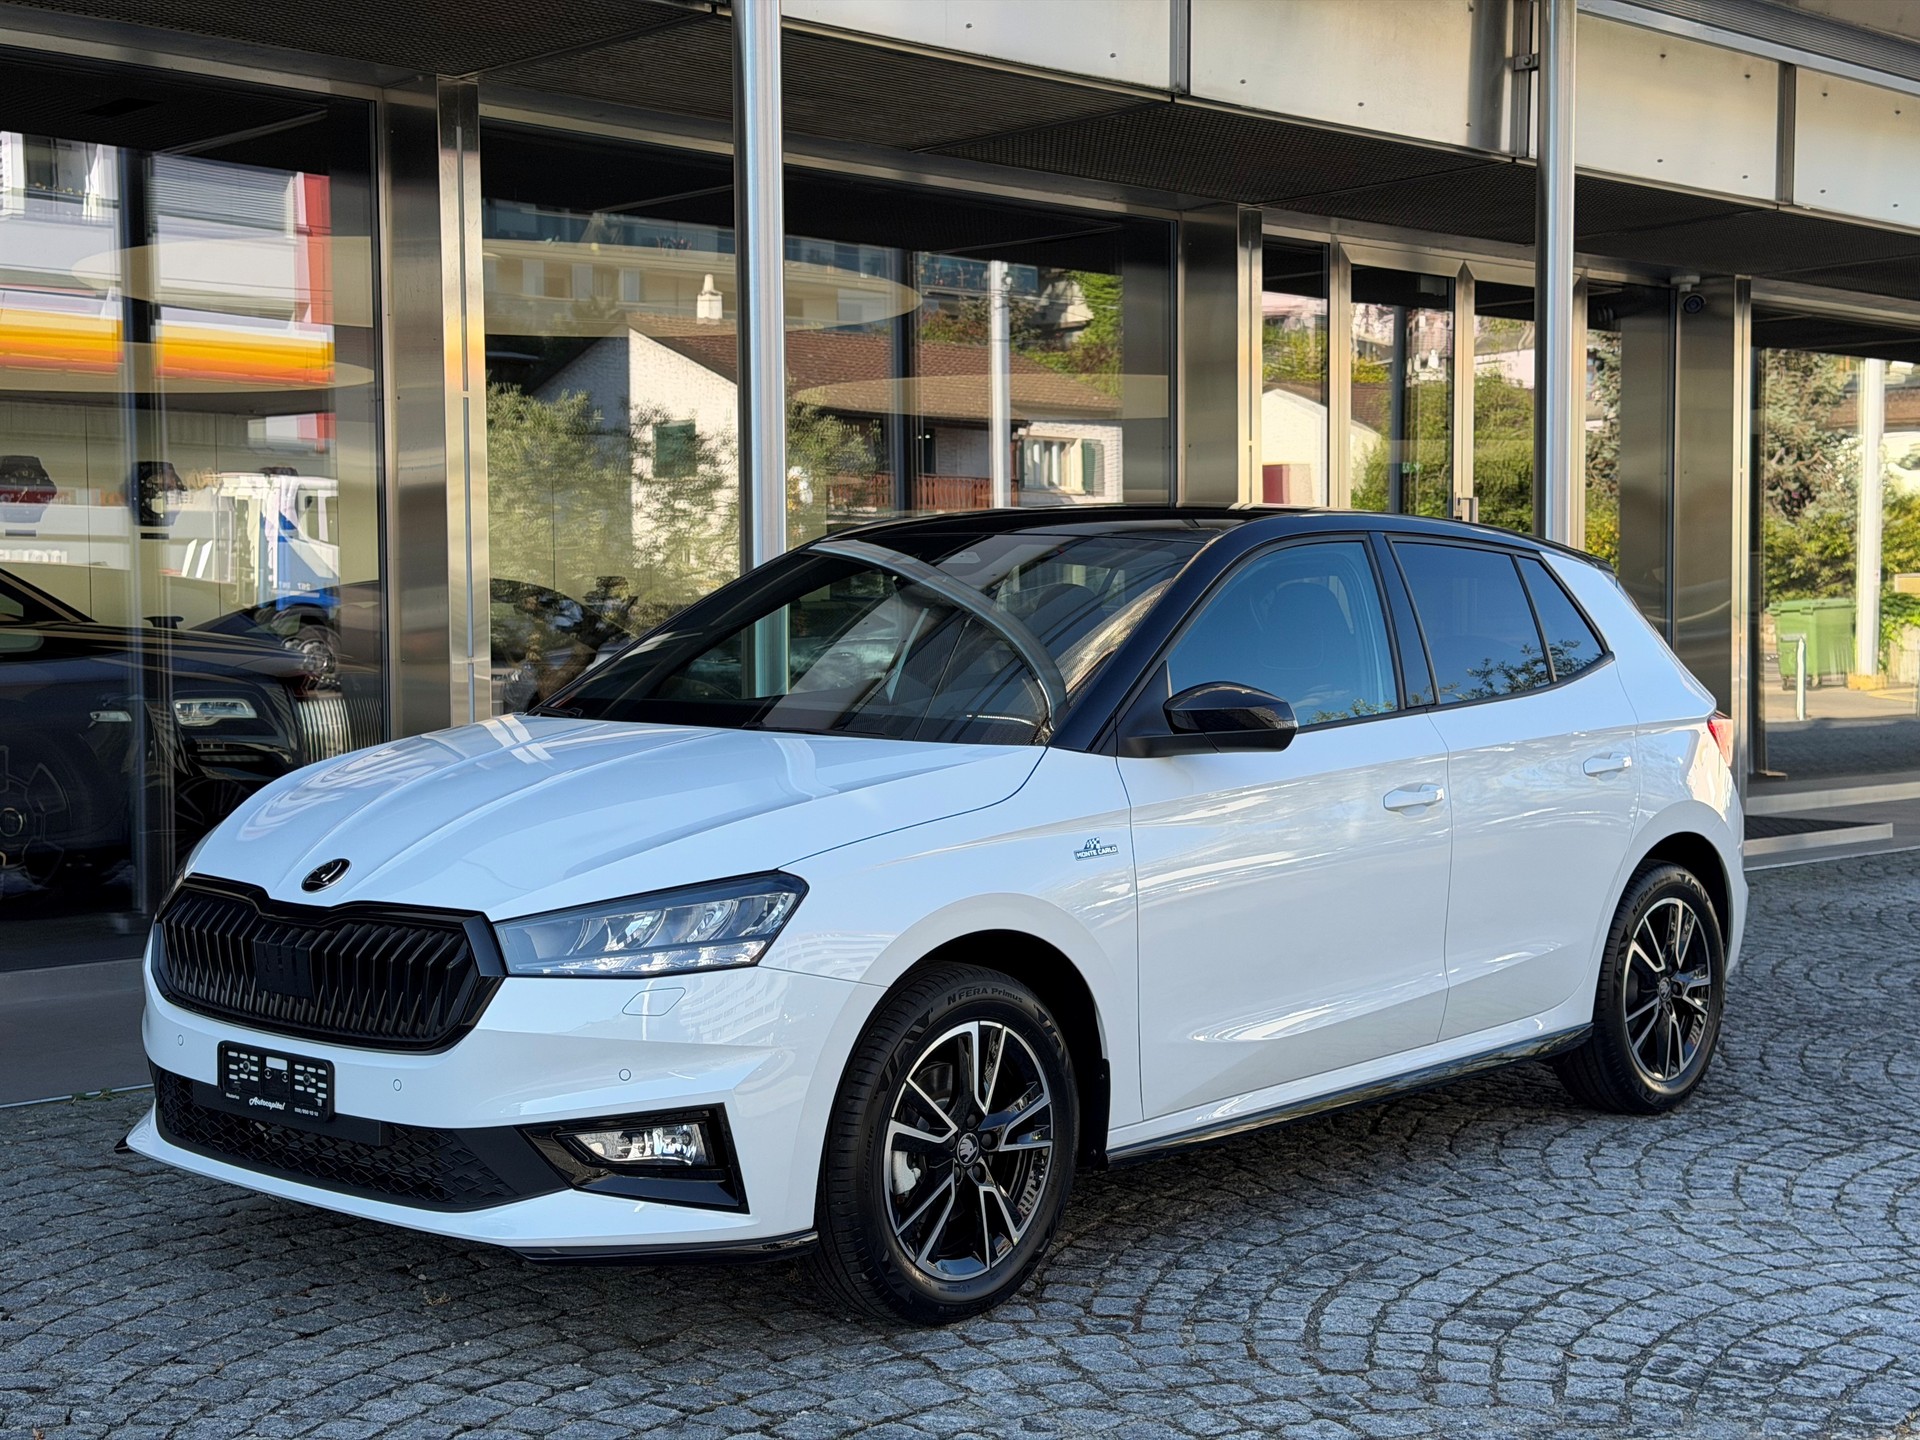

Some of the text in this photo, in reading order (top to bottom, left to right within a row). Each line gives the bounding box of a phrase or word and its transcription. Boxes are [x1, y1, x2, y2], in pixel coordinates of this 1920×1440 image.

[1076, 846, 1117, 859] MONTE CARLO
[991, 988, 1023, 1003] Primus
[248, 1096, 286, 1110] Autocapital
